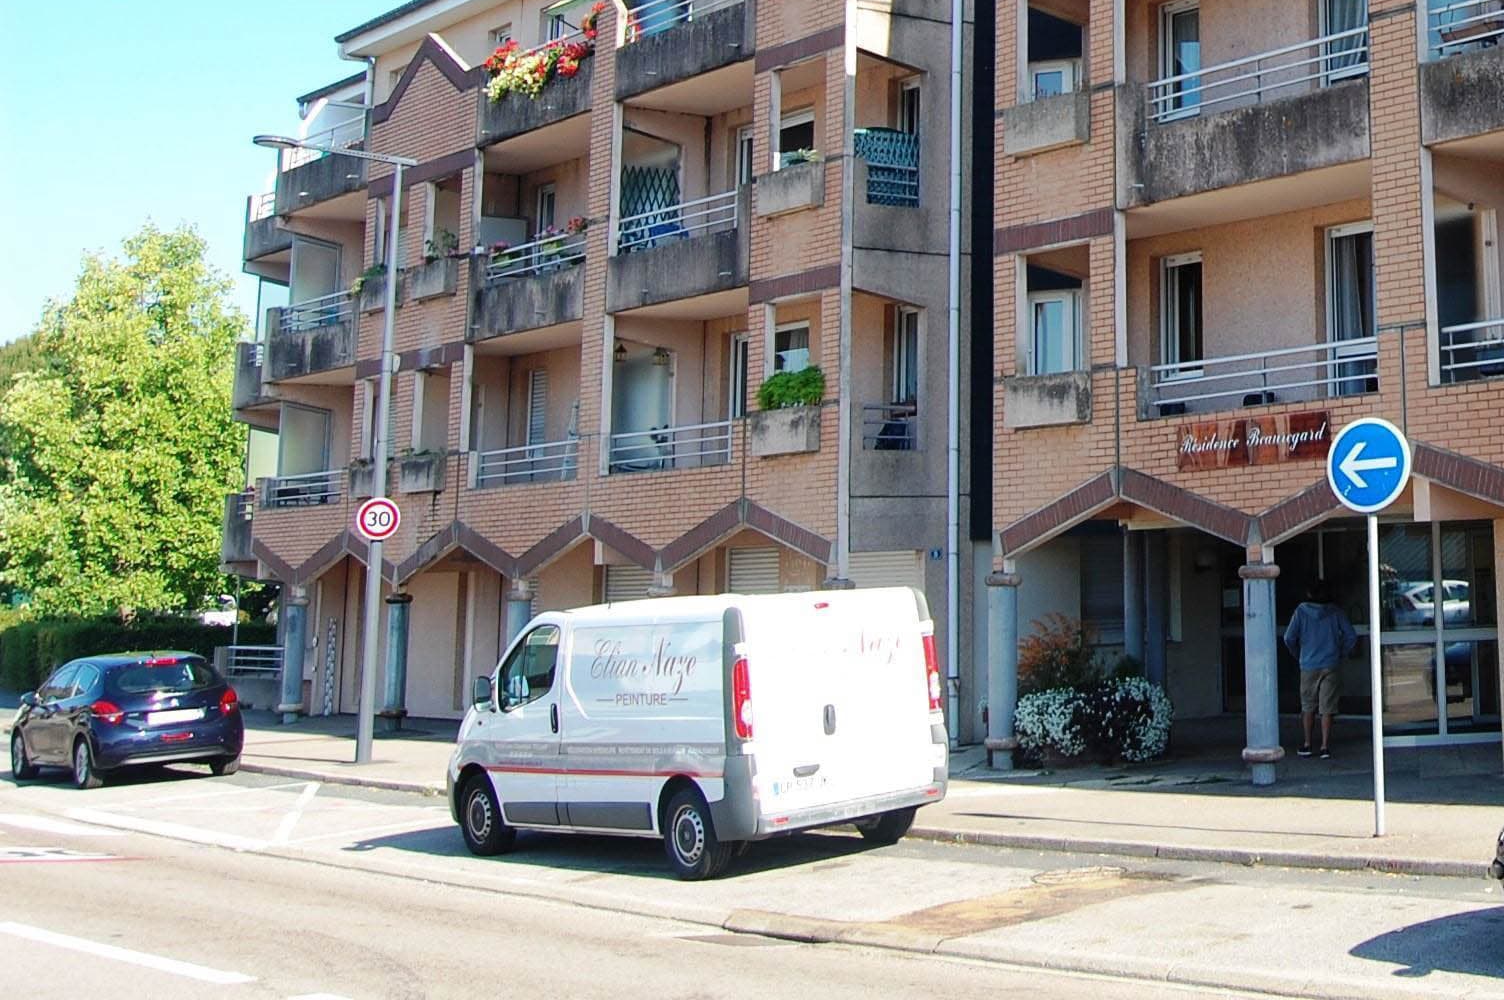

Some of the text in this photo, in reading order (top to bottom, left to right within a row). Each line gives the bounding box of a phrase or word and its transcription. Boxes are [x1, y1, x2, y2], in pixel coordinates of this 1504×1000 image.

[1246, 421, 1327, 452] Beauregard
[367, 511, 391, 527] 30
[590, 637, 697, 697] Elian Naze
[615, 692, 668, 706] PEINTURE
